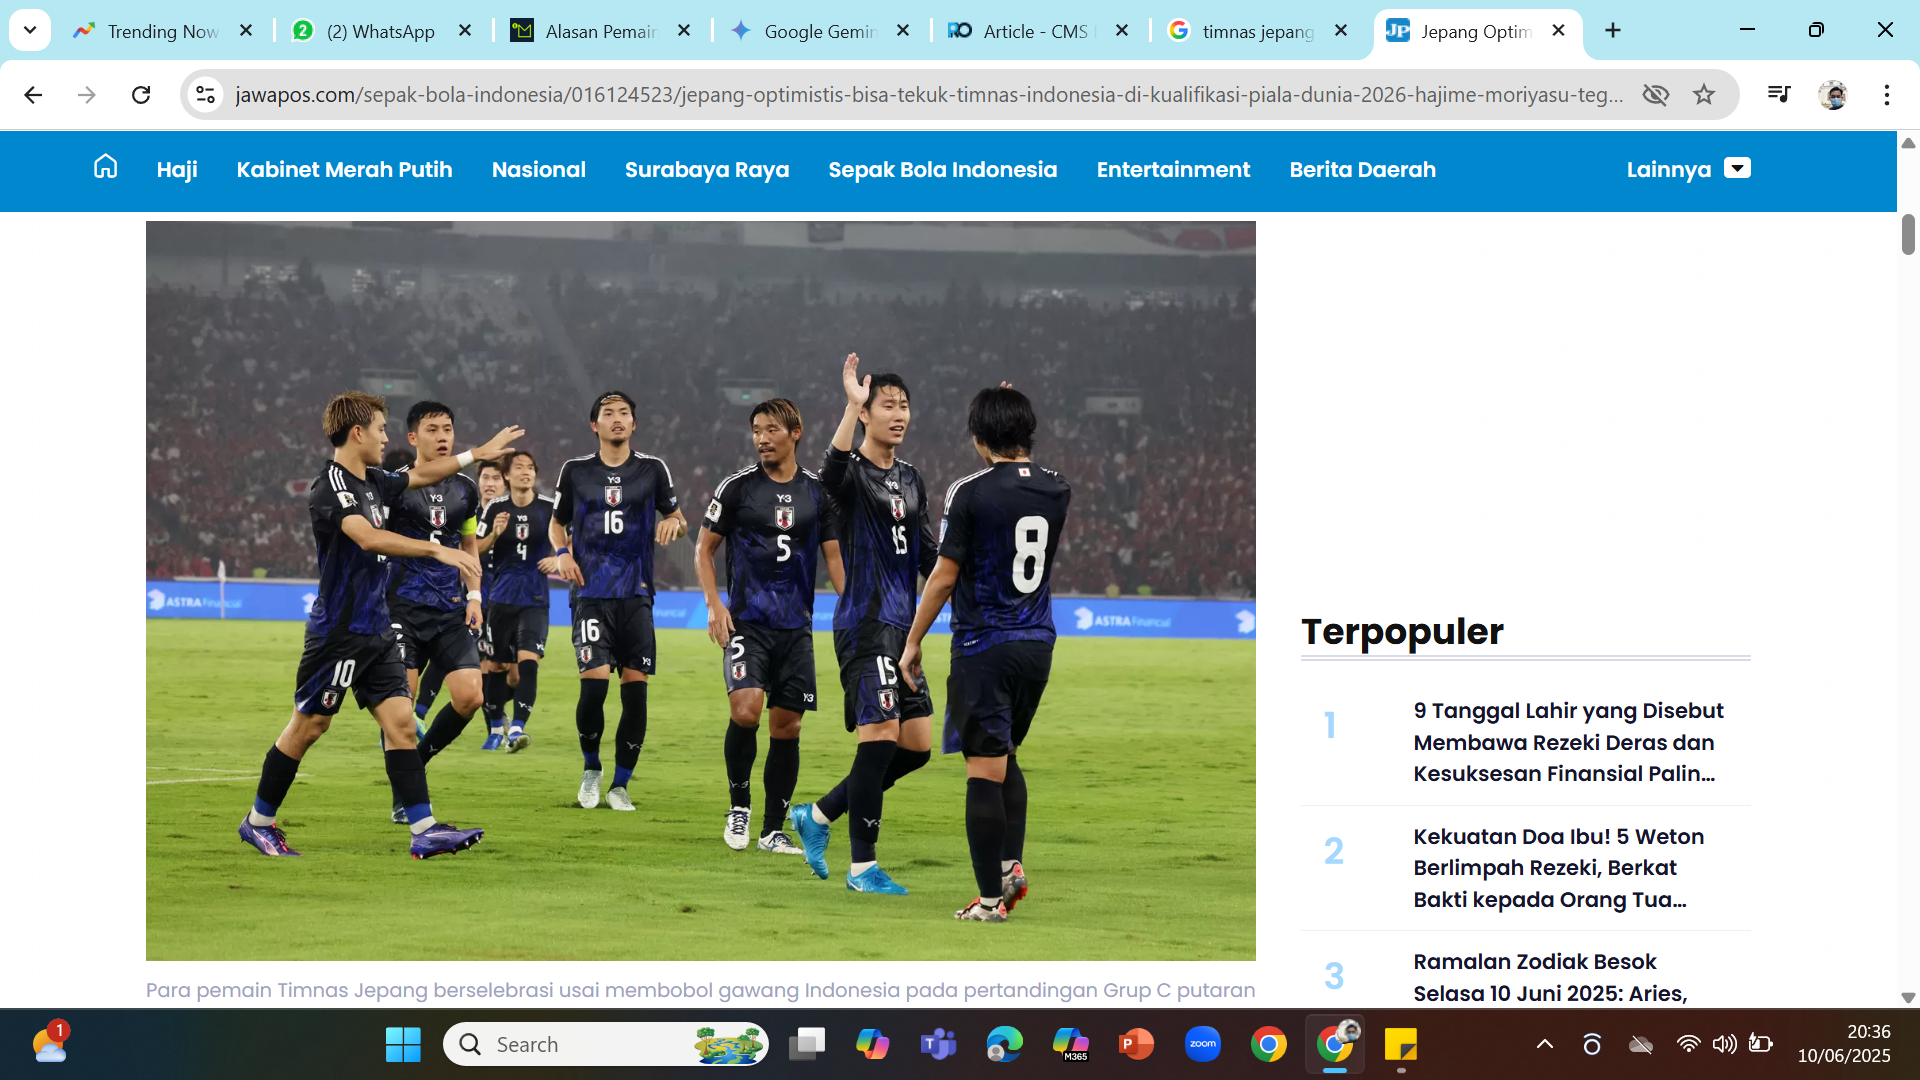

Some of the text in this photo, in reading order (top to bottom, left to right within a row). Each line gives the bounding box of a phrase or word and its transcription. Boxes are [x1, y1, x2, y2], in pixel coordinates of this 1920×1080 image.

[108, 24, 219, 42] Trending Now
[328, 24, 434, 42] (2) WhatsApp
[546, 24, 597, 38] Alasan
[765, 24, 823, 42] Google
[984, 24, 1034, 38] Article
[1052, 25, 1087, 38] CMS
[1203, 25, 1313, 42] timnas jepang
[1422, 25, 1477, 42] Jepang
[158, 160, 197, 183] Haji
[238, 160, 452, 178] Kabinet Merah Putih
[493, 160, 585, 178] Nasional
[626, 161, 789, 183] Surabaya Raya
[829, 160, 1057, 183] Sepak Bola Indonesia
[1098, 160, 1251, 178] Entertainment
[1291, 160, 1436, 178] Berita Daerah
[1628, 160, 1711, 183] Lainnya
[604, 510, 624, 534] 16
[776, 534, 792, 562] 5
[891, 525, 908, 555] 15
[516, 542, 527, 561] 4
[1012, 515, 1049, 594] 8
[166, 597, 202, 608] ASTRA
[1095, 615, 1131, 627] ASTRA
[581, 618, 600, 643] 16
[1301, 617, 1504, 654] Terpopuler
[730, 635, 745, 660] 5
[331, 659, 356, 688] 10
[876, 655, 898, 686] 15
[1414, 701, 1724, 724] 9 Tanggal Lahir yang Disebut
[1325, 712, 1334, 738] 1
[1414, 733, 1714, 750] Membawa Rezeki Deras dan
[1414, 765, 1541, 781] Kesuksesan
[1548, 764, 1642, 781] Finansial
[1414, 828, 1704, 844] Kekuatan Doa Ibu! 5 Weton
[1325, 837, 1343, 864] 2
[1414, 858, 1677, 881] Berlimpah Rezeki, Berkat
[1414, 890, 1467, 907] Bakti
[1473, 891, 1554, 913] kepada
[1560, 892, 1626, 913] Orang
[1414, 952, 1657, 969] Ramalan Zodiak Besok
[1325, 962, 1344, 989] 3
[147, 982, 1255, 1002] Para pemain Timnas Jepang berselebrasi usai membobol gawang Indonesia pada pertandingan Grup C putaran
[1414, 984, 1687, 1004] Selasa 10 Juni 2025: Aries,
[56, 1023, 63, 1037] 1
[1848, 1025, 1891, 1038] 20:36
[498, 1036, 557, 1052] Search
[1190, 1040, 1217, 1048] zoom
[1064, 1052, 1088, 1061] M365
[1799, 1049, 1890, 1064] 10/06/2025
